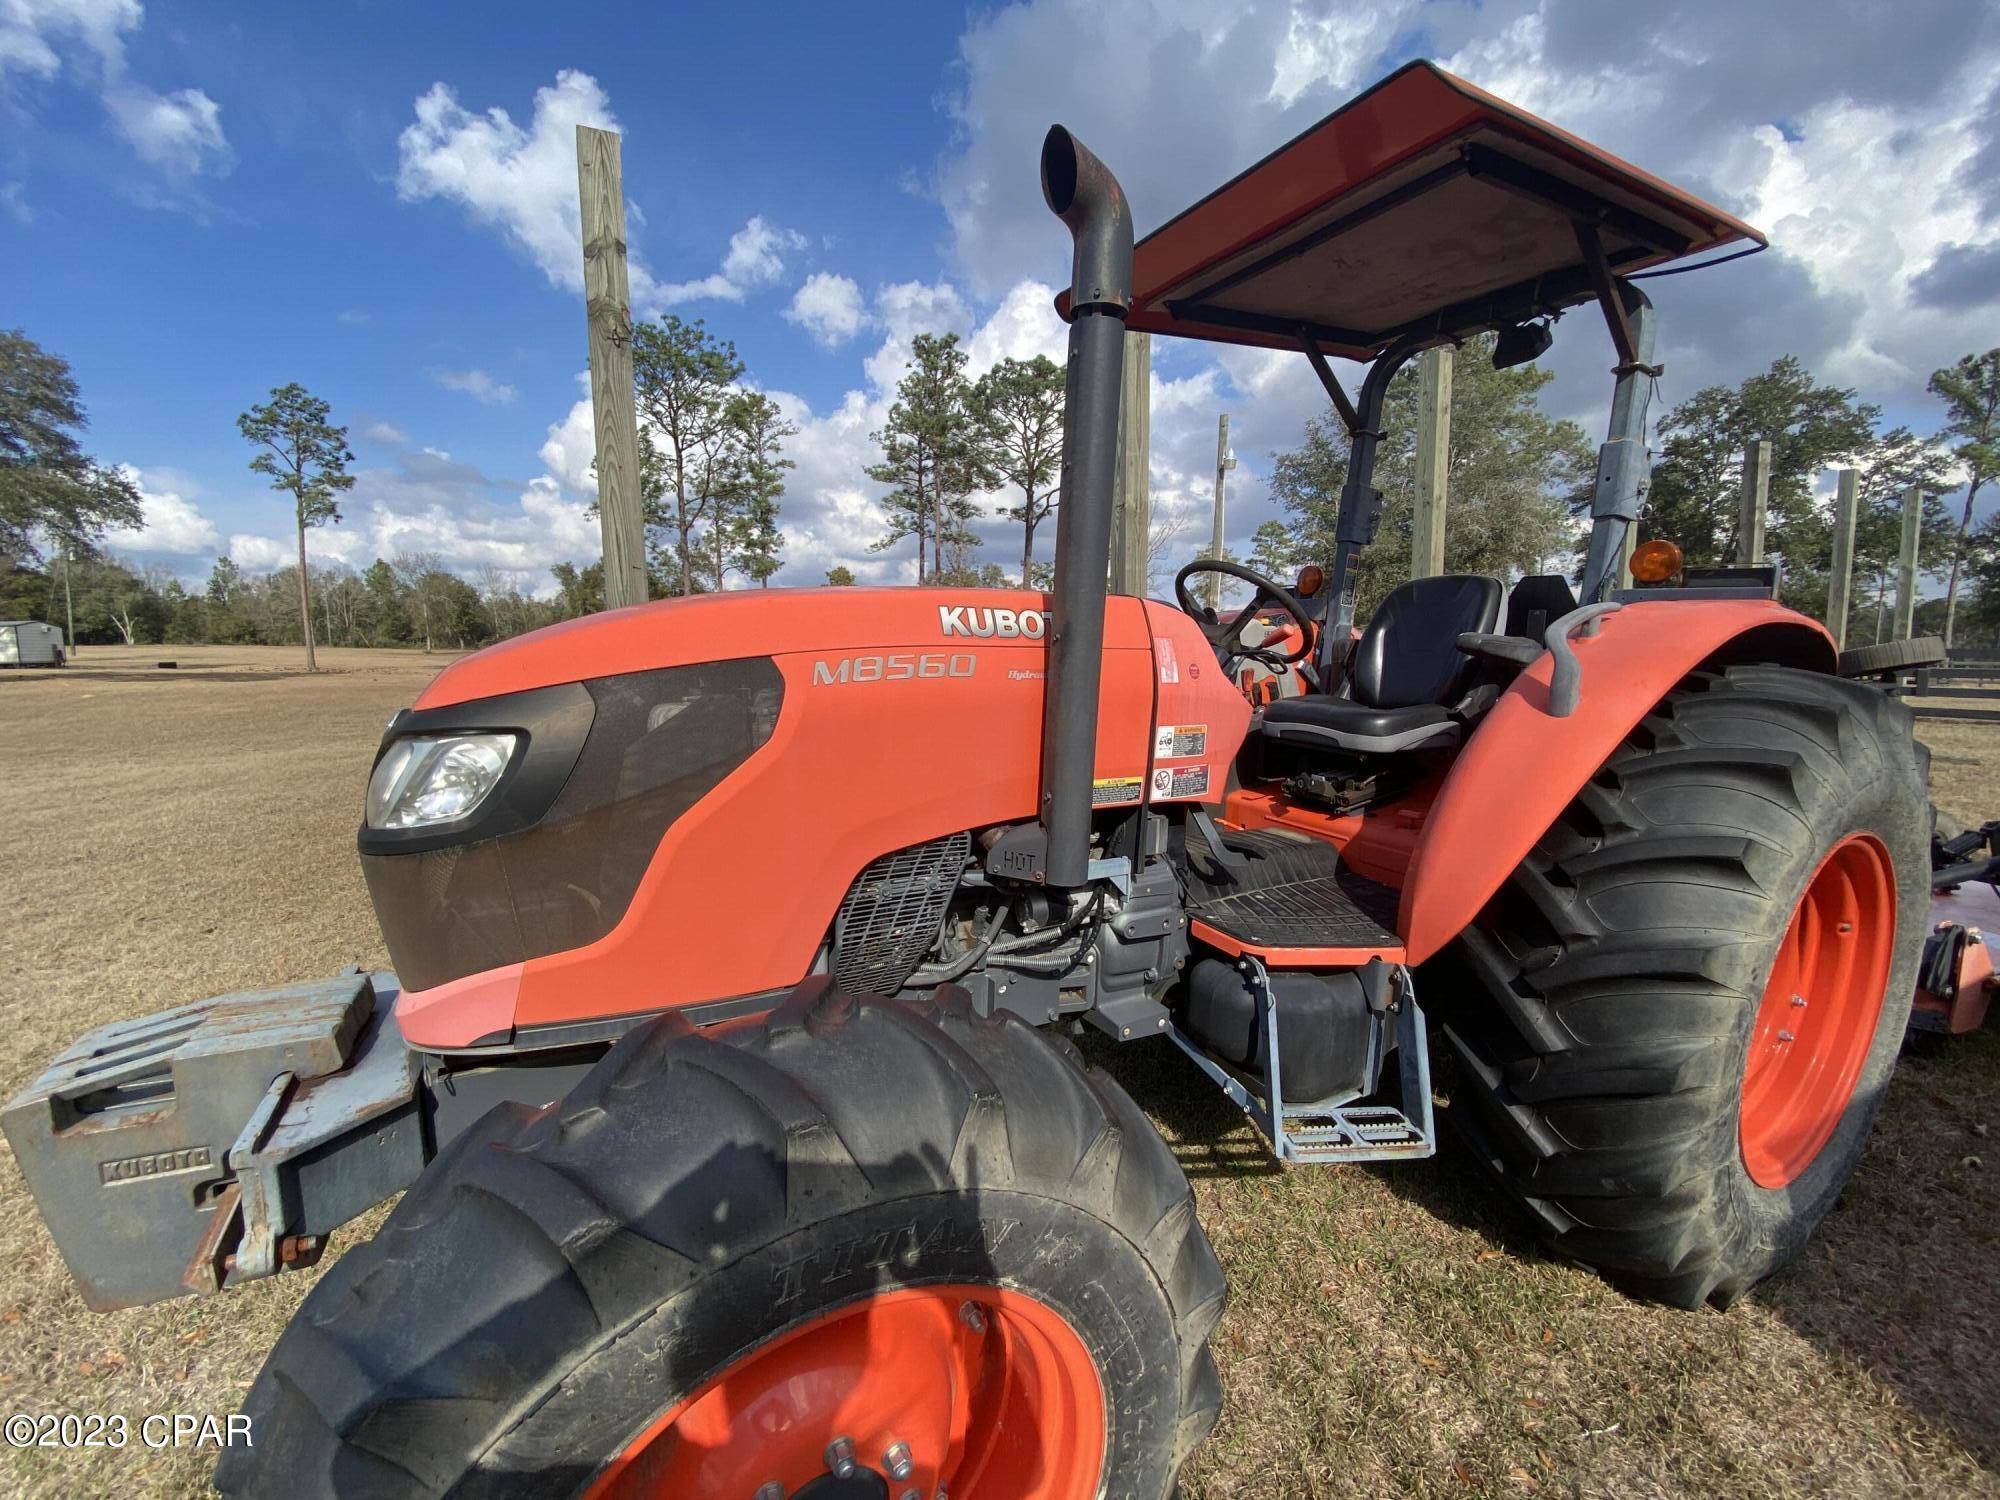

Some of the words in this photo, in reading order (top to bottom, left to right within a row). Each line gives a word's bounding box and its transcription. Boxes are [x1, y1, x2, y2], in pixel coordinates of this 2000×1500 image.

[938, 605, 1053, 640] KUBO
[812, 654, 976, 686] M8560
[1004, 850, 1036, 873] HOT
[103, 1149, 211, 1183] KUBOTA
